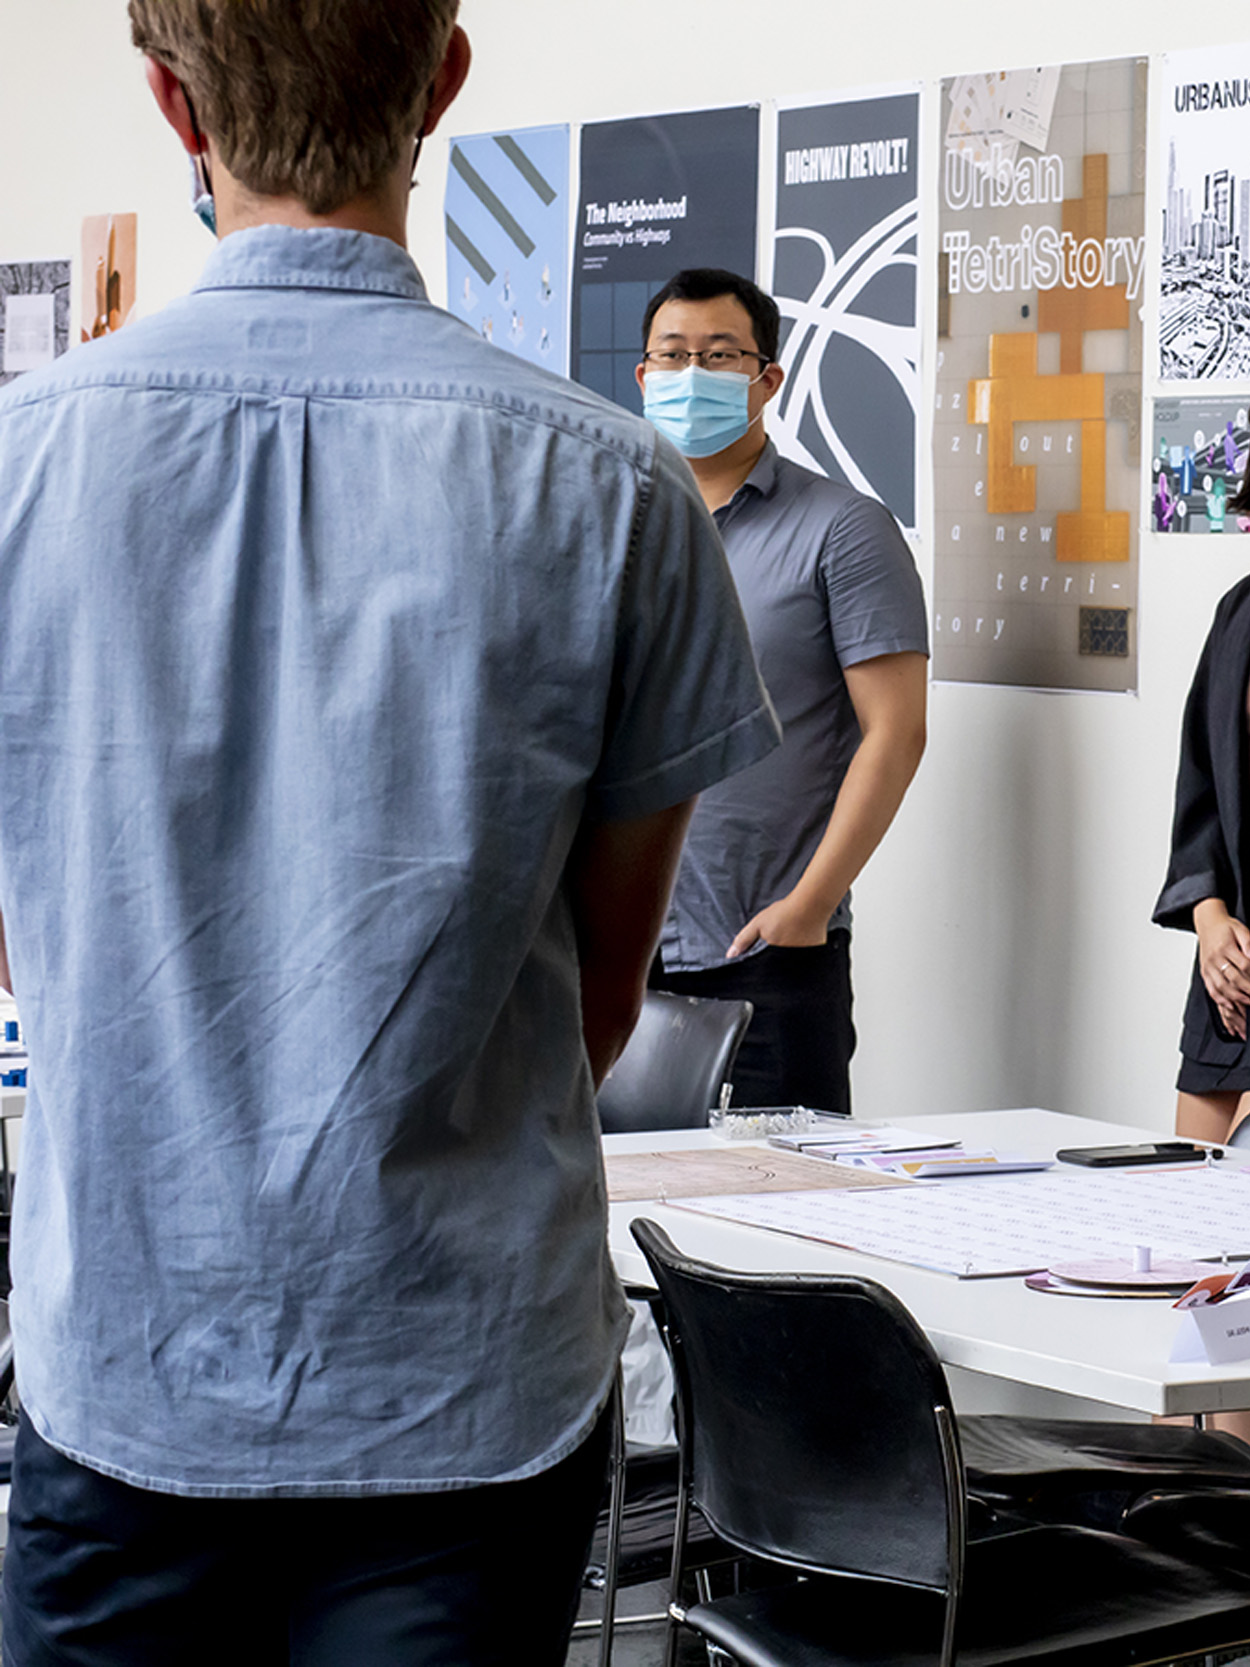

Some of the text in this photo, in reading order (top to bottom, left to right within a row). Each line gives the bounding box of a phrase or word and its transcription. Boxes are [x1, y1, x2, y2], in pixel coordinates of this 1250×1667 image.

[784, 138, 909, 185] HIGHWAY REVOLT!
[945, 143, 1064, 210] Urban
[586, 195, 687, 227] The Neighborhood
[583, 228, 670, 248] Community vs Highways
[943, 225, 1146, 299] TetriStory
[1020, 434, 1073, 454] out
[995, 525, 1053, 543] new
[935, 613, 1005, 641] tory
